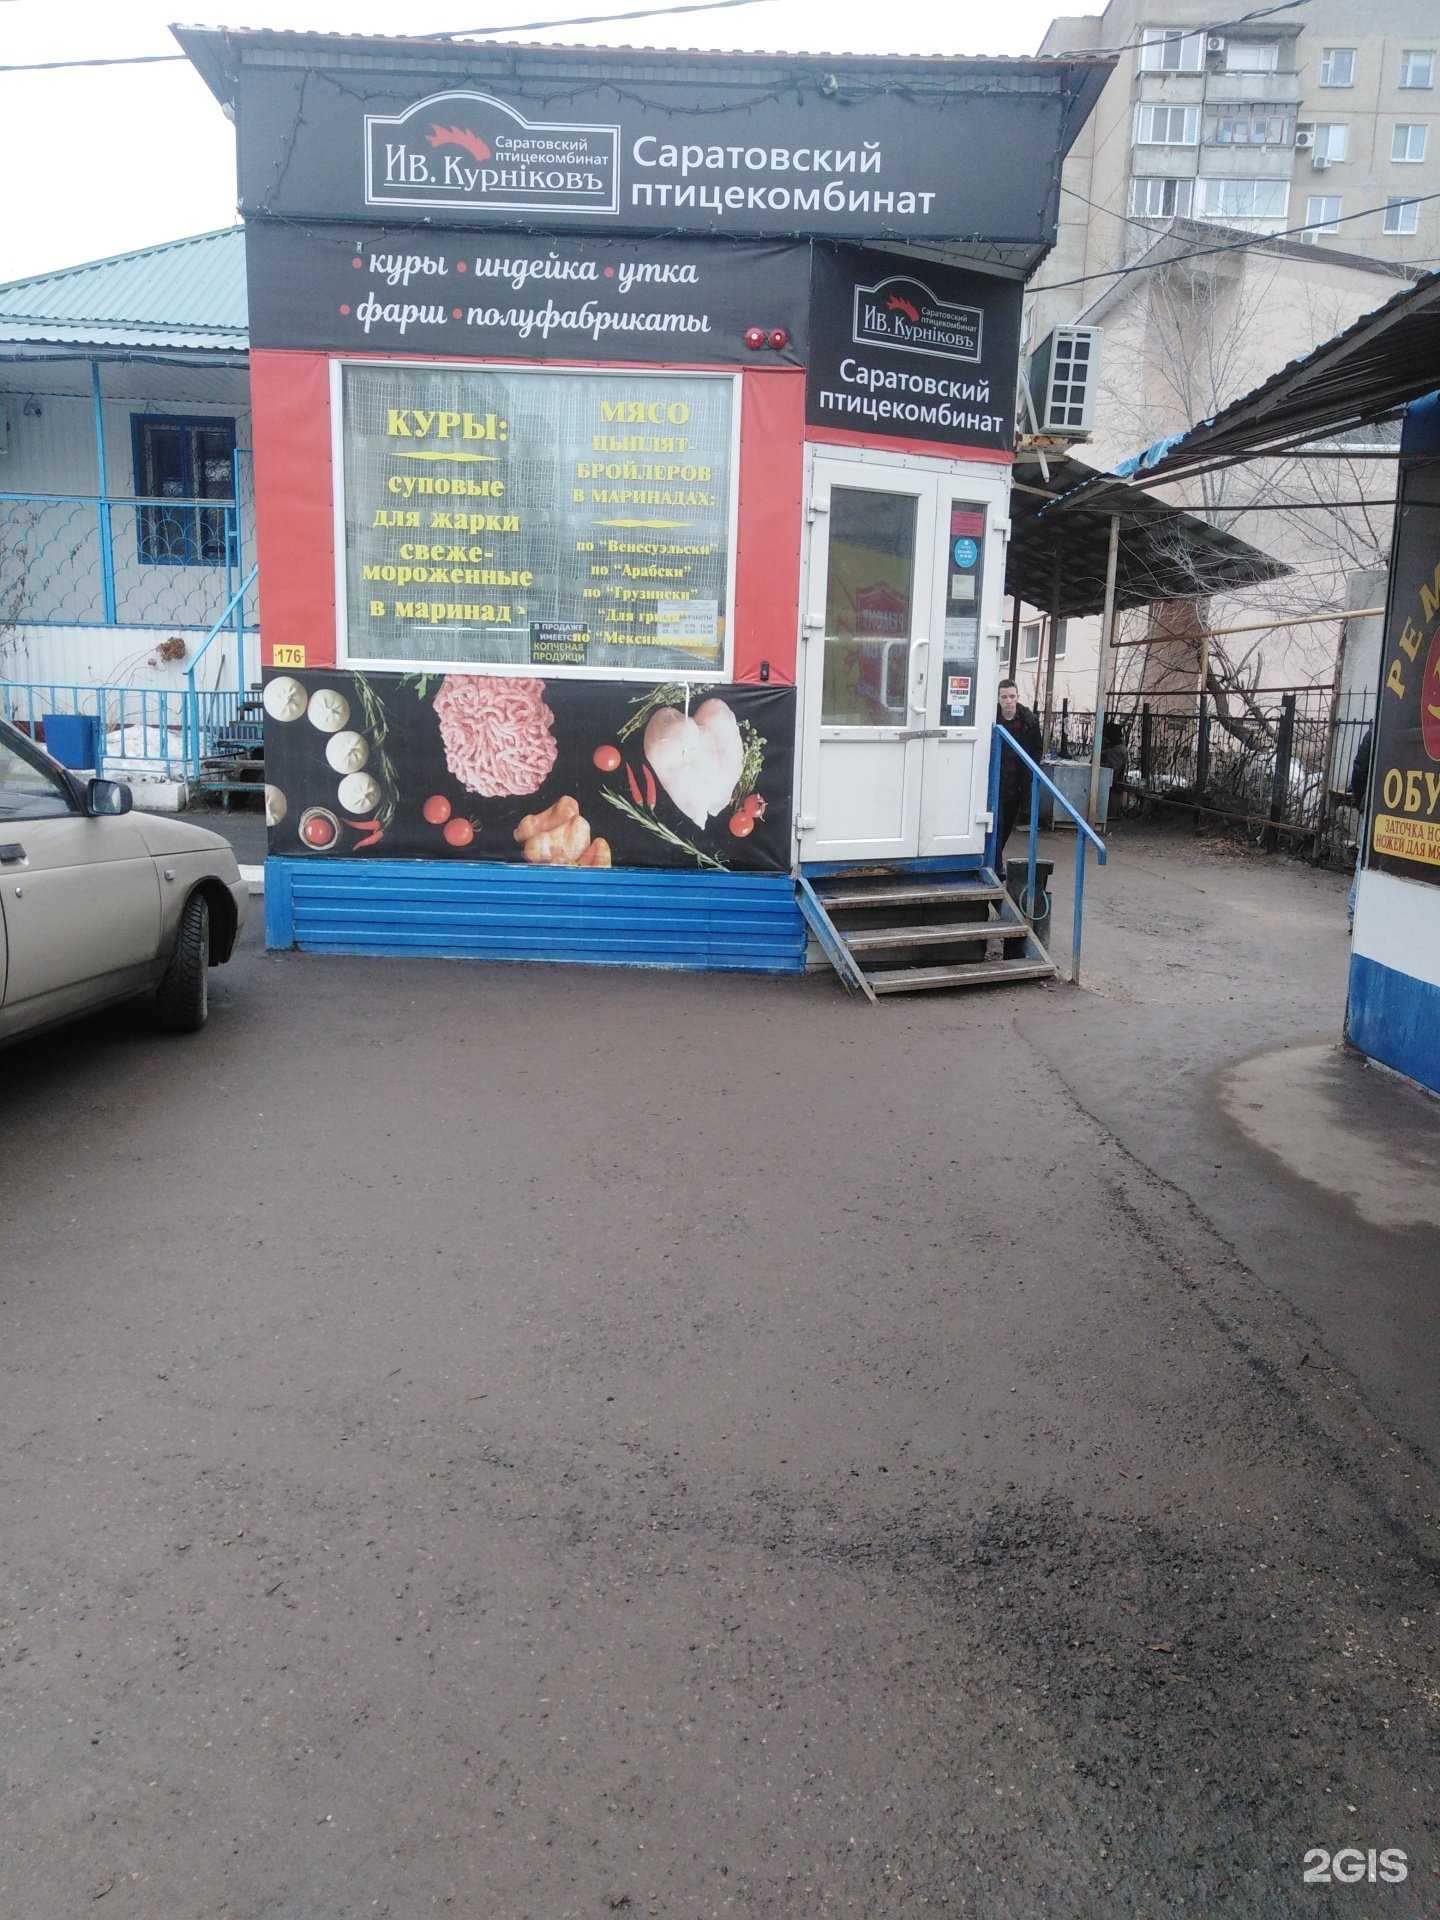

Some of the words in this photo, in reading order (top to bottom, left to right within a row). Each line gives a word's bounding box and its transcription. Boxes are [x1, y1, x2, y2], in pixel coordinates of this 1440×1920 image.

[495, 136, 588, 153] Саратовский
[632, 136, 882, 174] Саратовский
[384, 143, 436, 183] Ив.
[495, 152, 609, 165] птицекомбинат
[631, 180, 936, 215] птицекомбинат
[369, 253, 448, 286] куры
[474, 252, 599, 289] индейка
[617, 257, 700, 293] утка
[356, 291, 447, 334] фарш
[466, 300, 711, 341] полуфабрикаты
[864, 304, 891, 332] Ив.
[921, 306, 968, 323] Саратовский
[921, 316, 977, 333] птицекомбинат
[839, 358, 990, 403] Саратовский
[600, 400, 690, 425] МЯСО
[819, 390, 1004, 433] птицекомбинат
[387, 409, 508, 441] КУРЫ:
[576, 460, 711, 482] БРОЙЛЕРОВ
[388, 475, 505, 497] суповые
[573, 488, 585, 503] В
[372, 510, 420, 529] для
[430, 511, 520, 535] жарки
[400, 543, 494, 563] свеже-
[576, 541, 594, 552] по
[362, 565, 534, 587] мороженные
[591, 565, 609, 576] по
[583, 587, 601, 598] по
[370, 600, 386, 616] в
[539, 633, 579, 642] ИМЕЕТС
[277, 649, 302, 663] 176
[1384, 819, 1424, 839] ЗАТОЧКА
[1376, 833, 1405, 852] НОЖЕЙ
[1406, 839, 1425, 856] ДЛЯ
